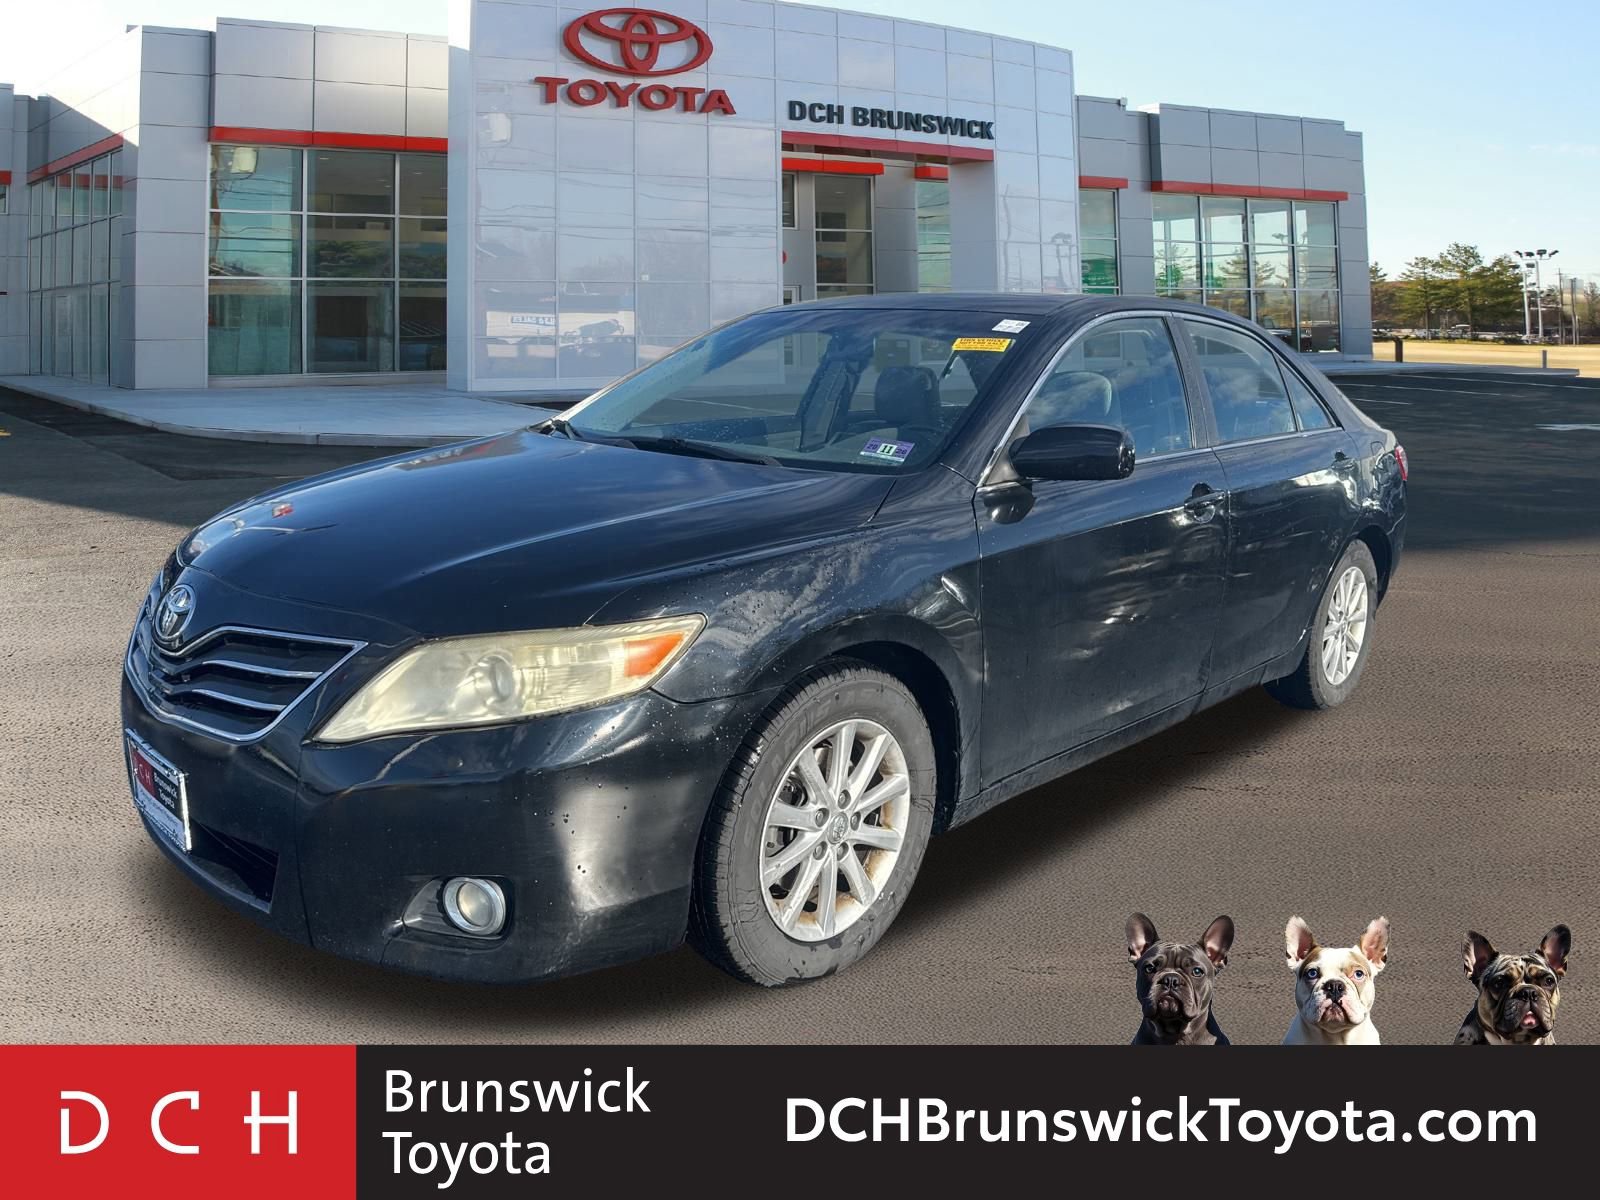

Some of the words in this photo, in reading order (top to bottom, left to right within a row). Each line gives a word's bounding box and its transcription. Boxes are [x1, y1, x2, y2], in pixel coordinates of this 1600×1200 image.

[535, 76, 736, 115] TOYOTA
[789, 100, 845, 125] DCH
[852, 106, 995, 140] BRUNSWICK
[880, 445, 894, 454] 11
[159, 789, 175, 809] Toyota
